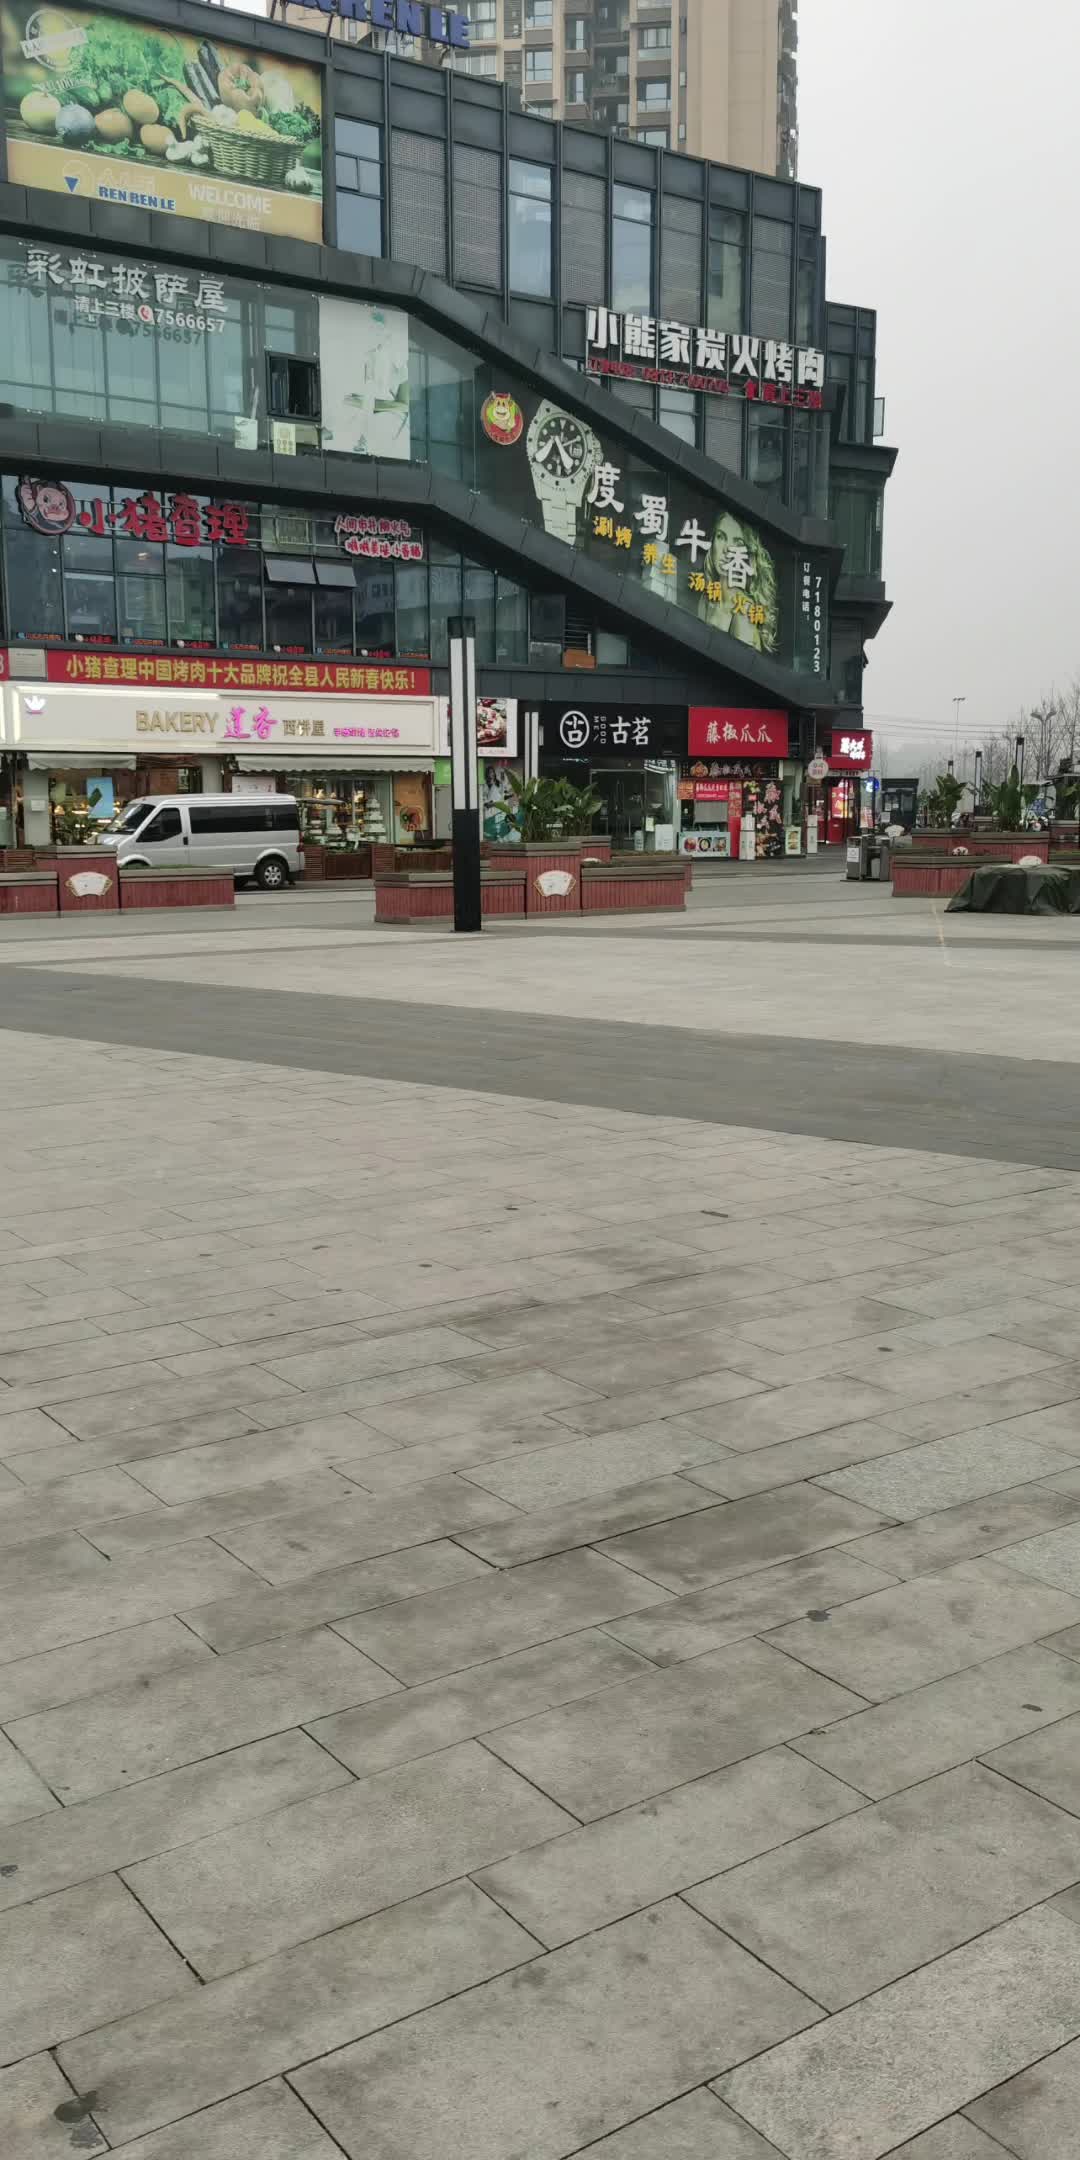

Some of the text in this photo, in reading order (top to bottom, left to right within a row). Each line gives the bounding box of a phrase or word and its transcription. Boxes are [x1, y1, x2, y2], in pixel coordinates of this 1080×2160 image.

[99, 185, 176, 211] REN REN LE
[189, 182, 273, 215] WELCOME
[27, 249, 228, 313] 彩虹披萨屋
[75, 295, 225, 333] 请上三楼 7566657
[586, 306, 825, 389] 小熊家炭火烤肉
[79, 491, 249, 547] 小猪查理
[643, 543, 677, 576] 养生
[687, 571, 722, 602] 汤锅
[732, 592, 765, 625] 火锅
[813, 576, 822, 673] 7180123
[136, 709, 219, 734] BAKERY
[282, 719, 326, 737] 西饼屋
[609, 716, 652, 746] 古茗
[705, 720, 773, 745] 藤椒爪爪
